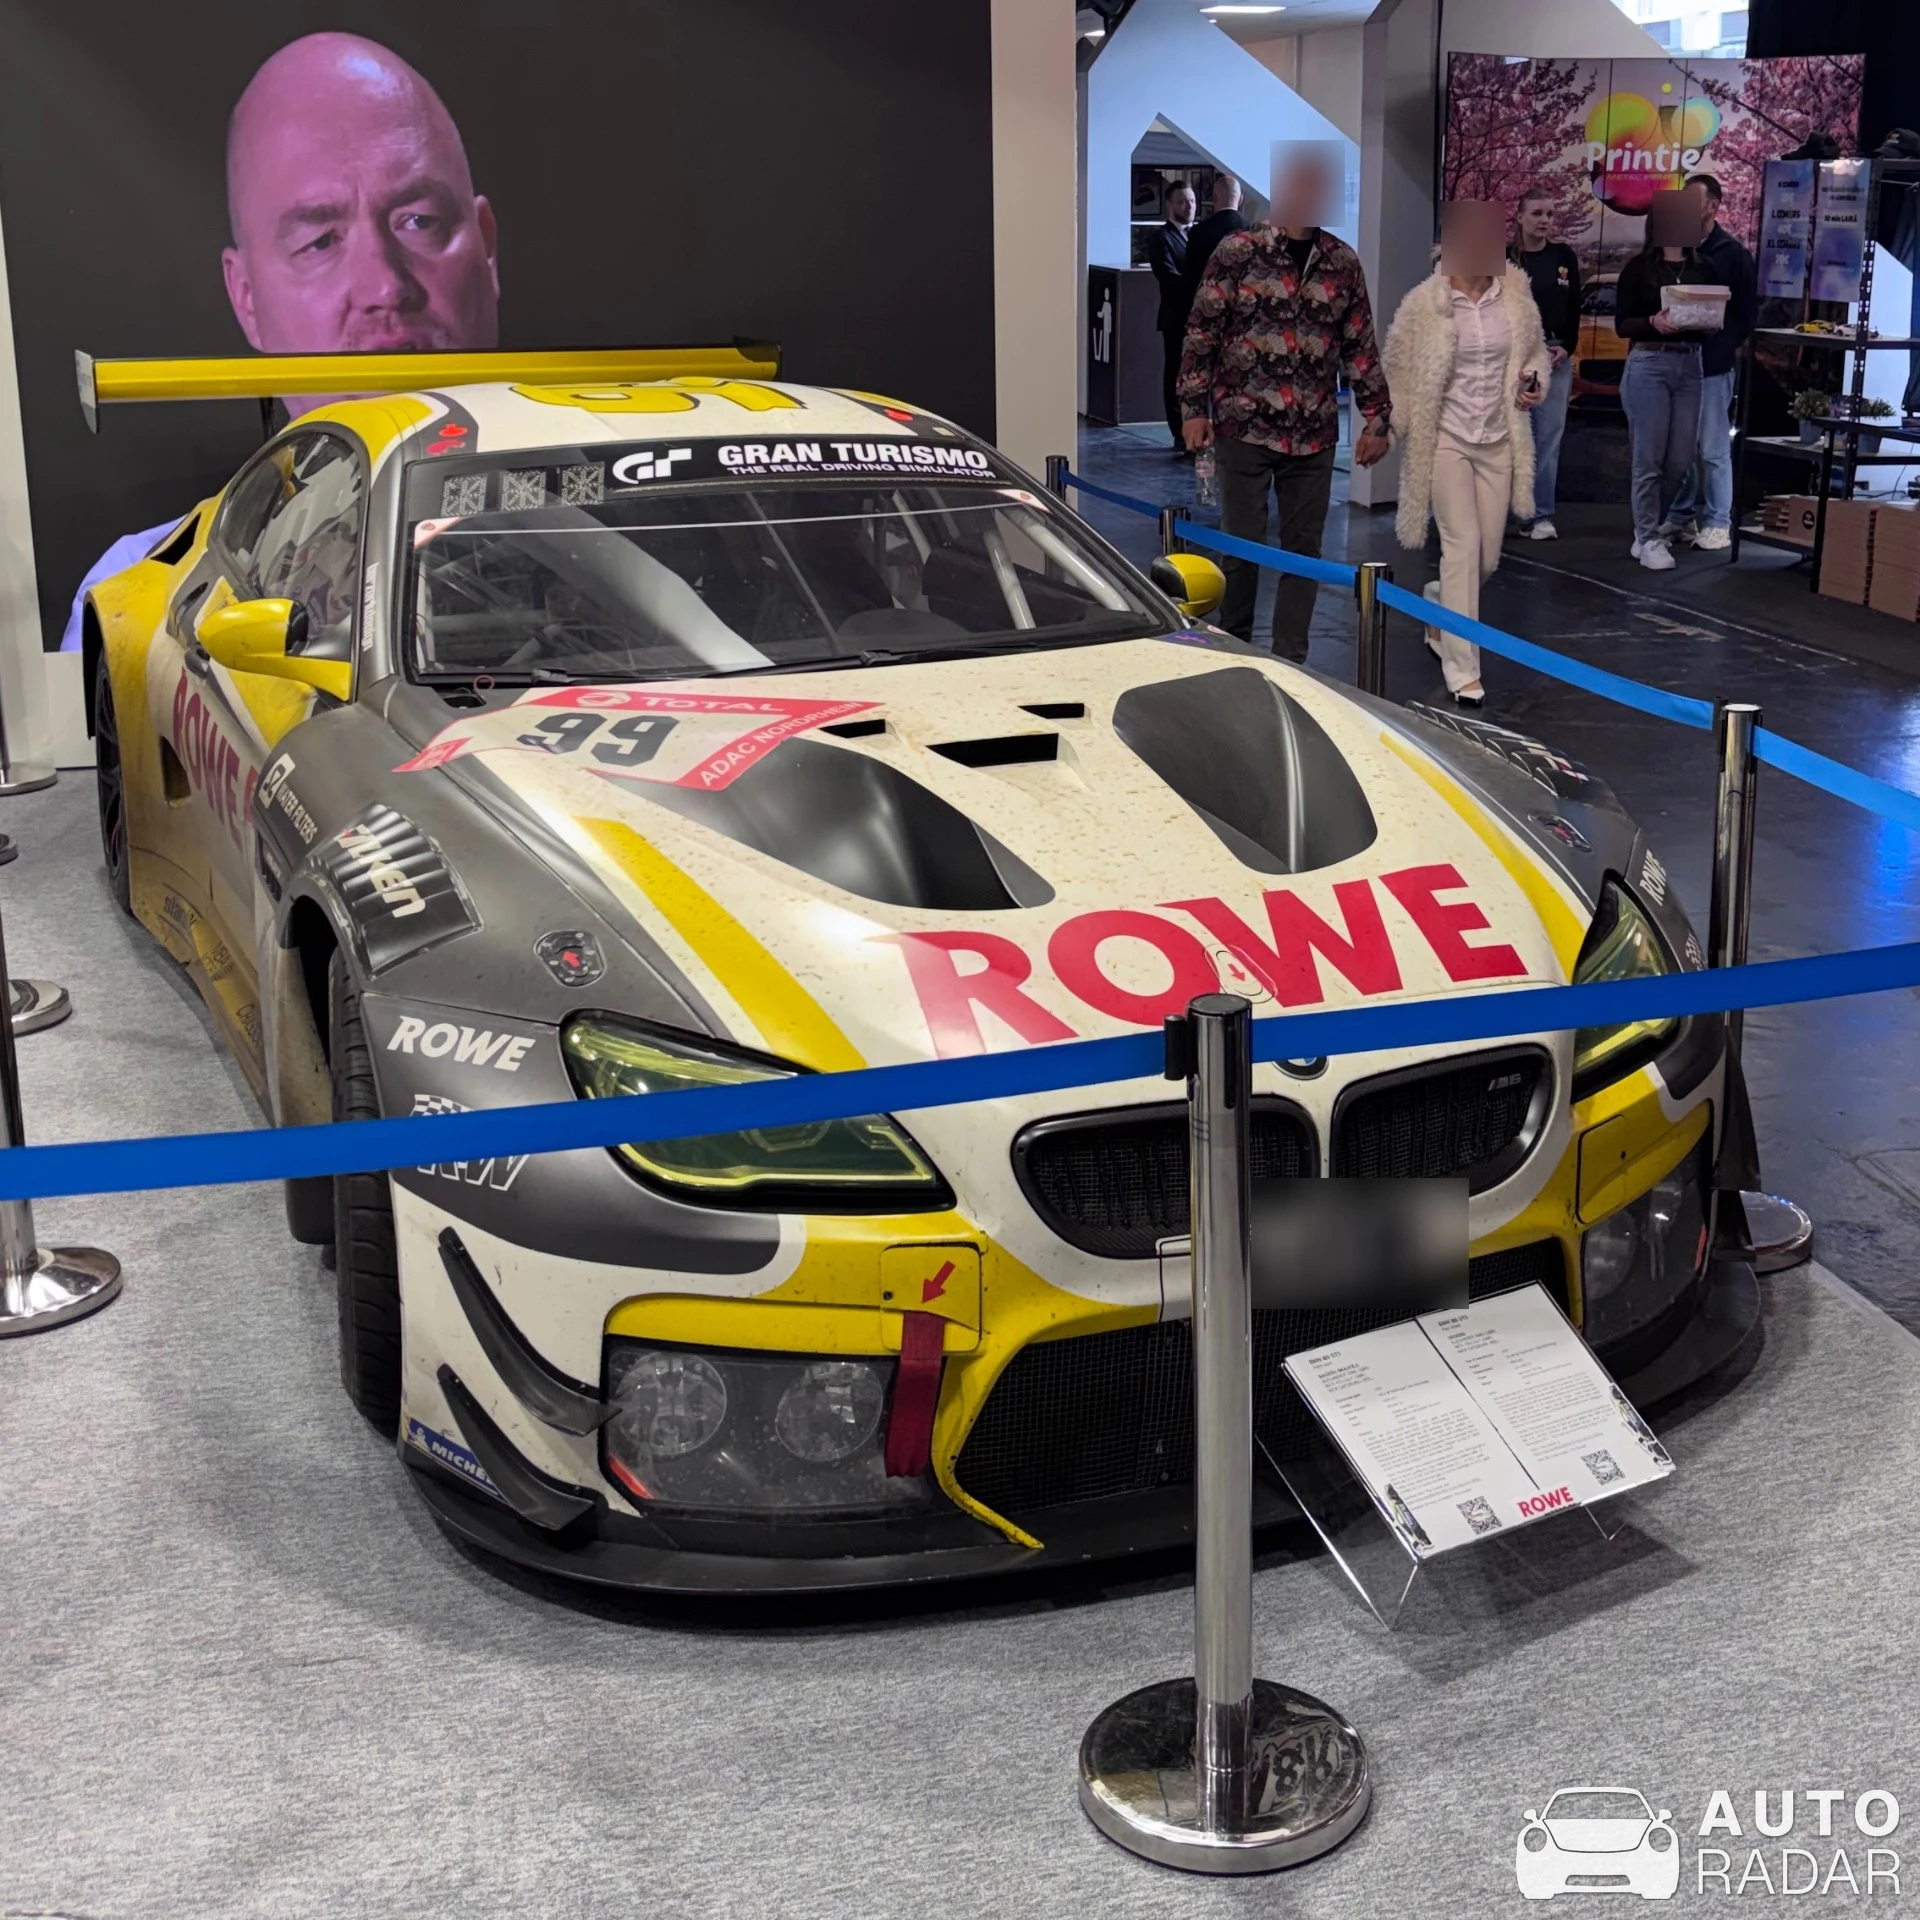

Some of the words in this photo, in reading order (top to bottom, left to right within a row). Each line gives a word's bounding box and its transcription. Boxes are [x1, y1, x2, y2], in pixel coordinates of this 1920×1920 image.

[1587, 141, 1700, 172] Printie
[718, 443, 823, 466] GRAN
[830, 443, 988, 469] TURISMO
[727, 465, 767, 475] THE
[769, 464, 819, 473] REAL
[820, 463, 896, 472] DRIVING
[897, 464, 997, 478] SIMULATOR
[641, 696, 785, 712] TOTAL
[173, 665, 244, 854] ROWE
[516, 712, 680, 767] 99
[701, 742, 757, 787] ADAC
[753, 702, 864, 744] NORDRHEIN
[275, 781, 299, 820] WATER
[291, 802, 319, 845] FILTERS
[1639, 849, 1668, 906] ROWE
[866, 863, 1529, 1059] ROWE
[386, 1015, 537, 1072] ROWE
[1516, 1486, 1574, 1518] ROWE
